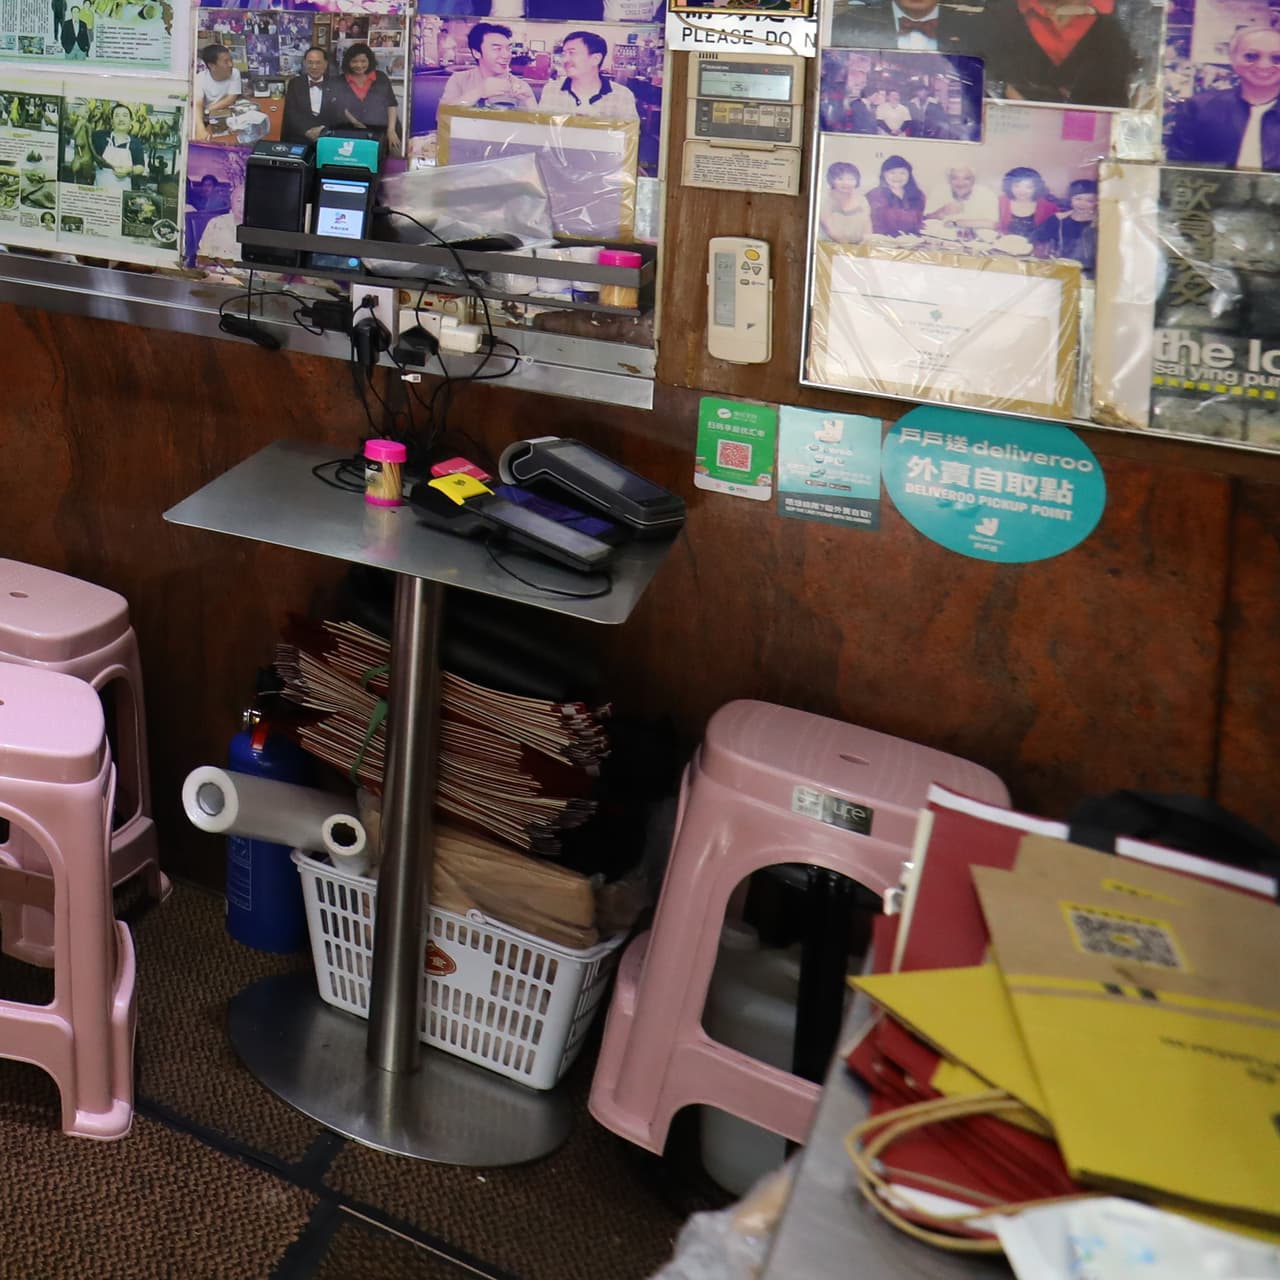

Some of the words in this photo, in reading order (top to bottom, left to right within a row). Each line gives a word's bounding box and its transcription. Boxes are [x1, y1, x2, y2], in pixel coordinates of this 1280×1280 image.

[682, 26, 753, 45] PLEASE
[765, 31, 793, 47] DO
[1154, 329, 1235, 369] the
[1154, 361, 1185, 376] sai
[1190, 365, 1238, 388] ying
[971, 440, 1094, 472] deliveroo
[906, 455, 1074, 506] 外賣自取點
[904, 483, 976, 504] DELIVEROO
[977, 495, 1029, 514] PICKUP
[1031, 503, 1073, 521] POINT
